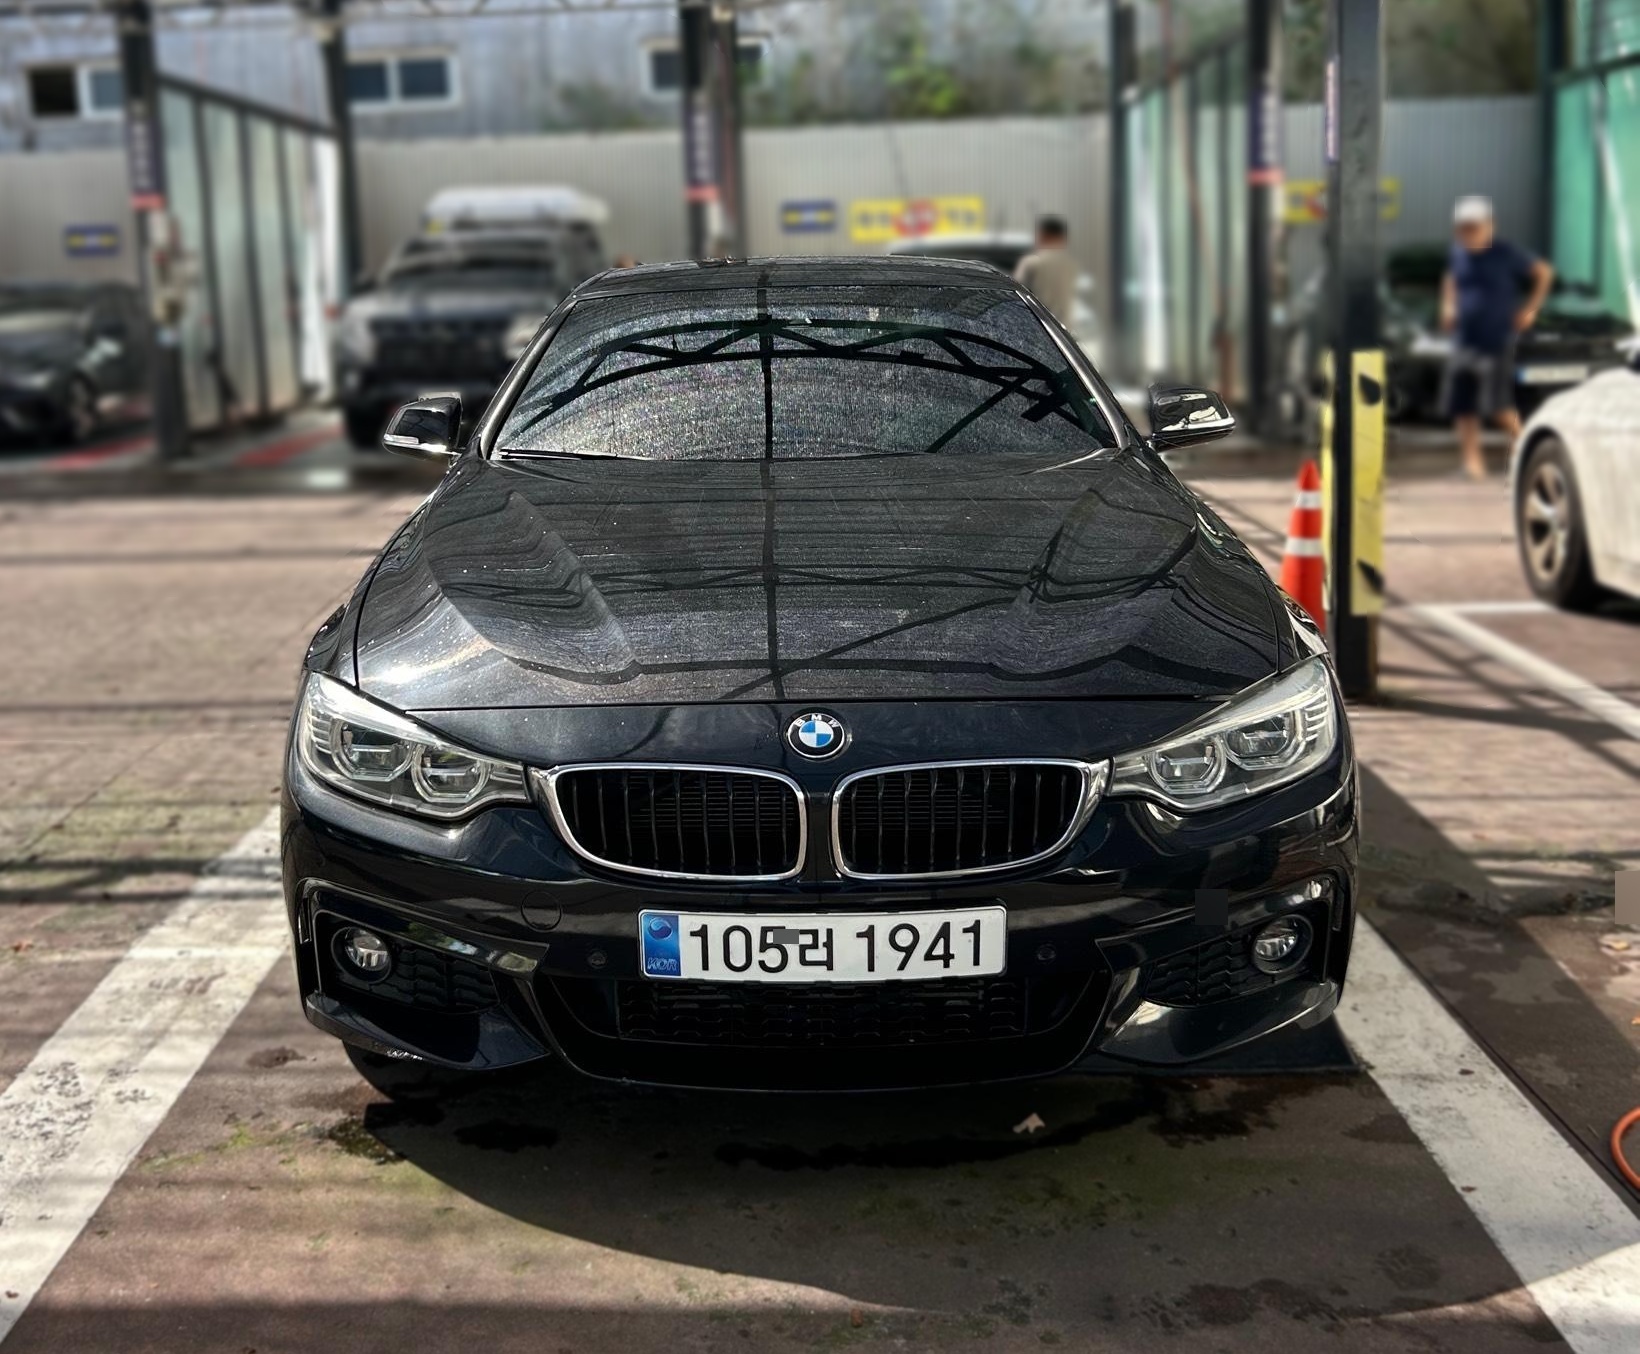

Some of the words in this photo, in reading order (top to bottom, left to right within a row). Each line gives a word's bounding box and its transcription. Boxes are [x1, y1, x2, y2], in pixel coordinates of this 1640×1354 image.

[793, 713, 841, 728] BMW
[689, 924, 834, 974] 105러
[856, 919, 982, 972] 1941
[647, 957, 678, 971] KOR
